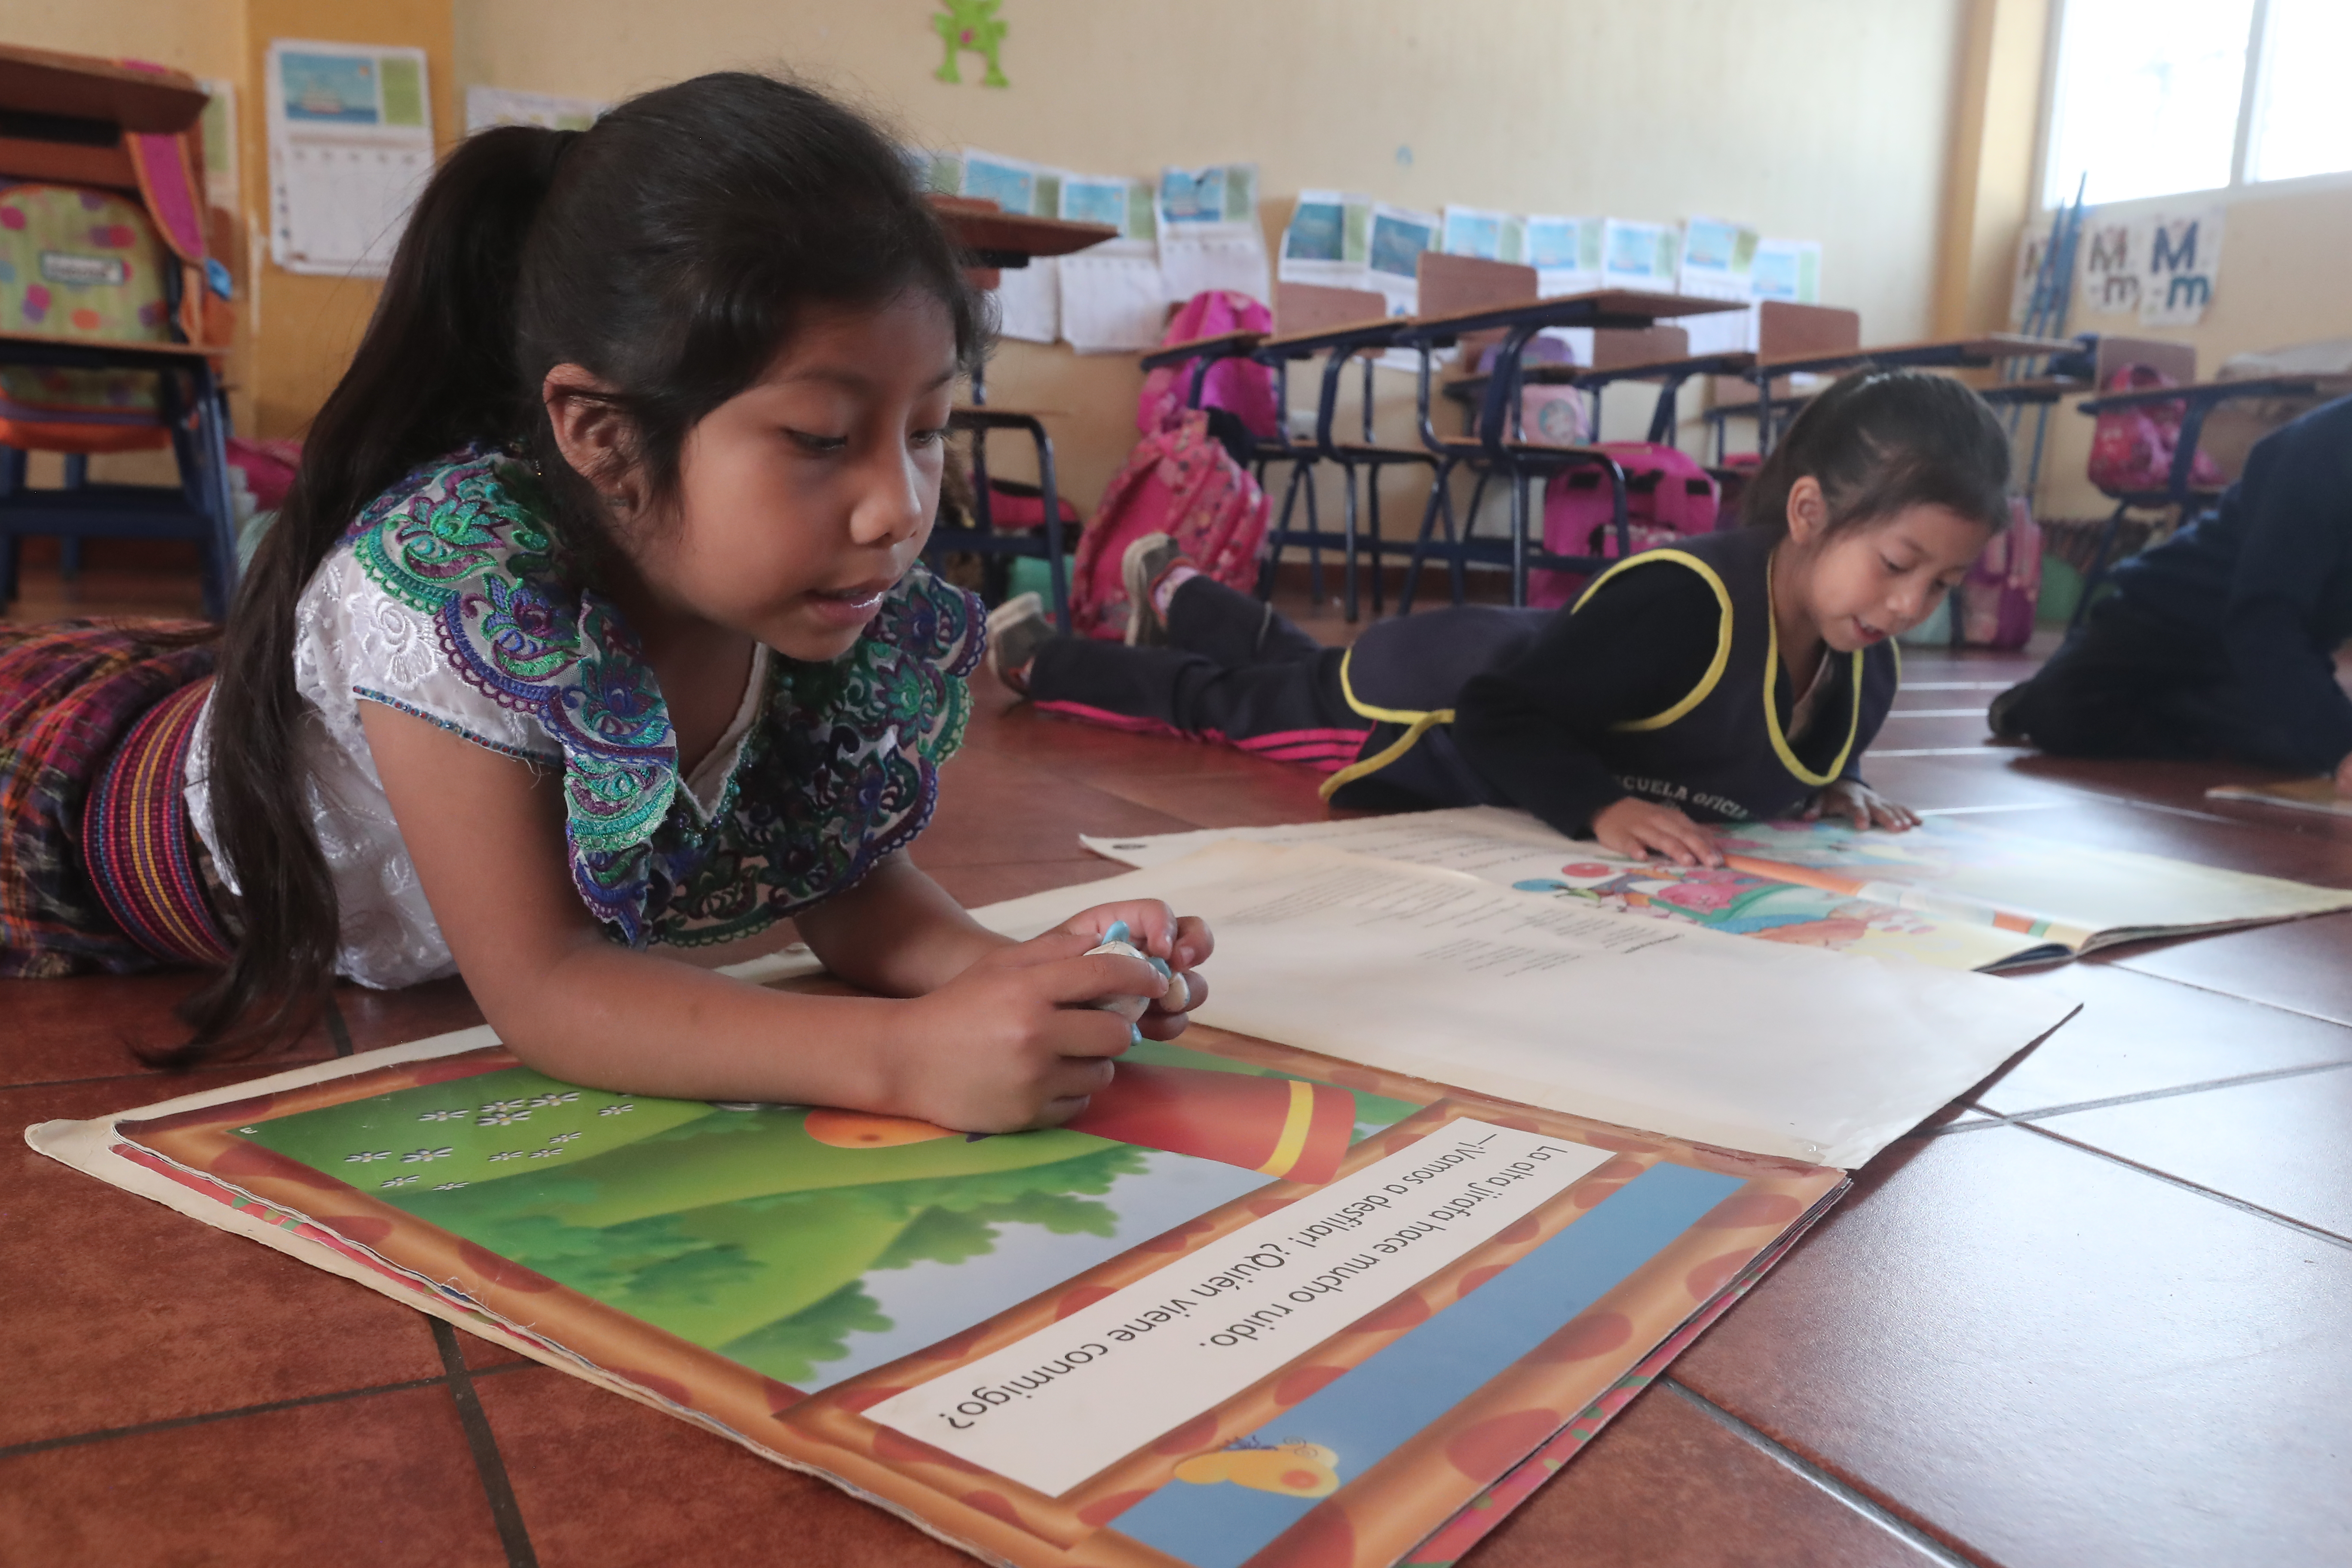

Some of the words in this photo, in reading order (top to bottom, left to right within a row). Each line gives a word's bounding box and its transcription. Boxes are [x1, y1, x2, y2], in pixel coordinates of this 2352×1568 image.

[2150, 220, 2199, 274] M
[2165, 275, 2210, 308] m
[239, 1127, 258, 1135] 3
[1526, 1145, 1568, 1161] La
[1381, 1184, 1409, 1195] a
[1485, 1162, 1535, 1187] alta
[1287, 1194, 1393, 1249] desfilar!
[1427, 1182, 1504, 1222] jirafa
[1372, 1221, 1447, 1254] hace
[1190, 1243, 1291, 1297] ¿Quién
[1288, 1253, 1381, 1303] mucho
[1106, 1298, 1199, 1342] viene
[1199, 1303, 1294, 1347] ruido.
[938, 1343, 1109, 1430] conmigo?
